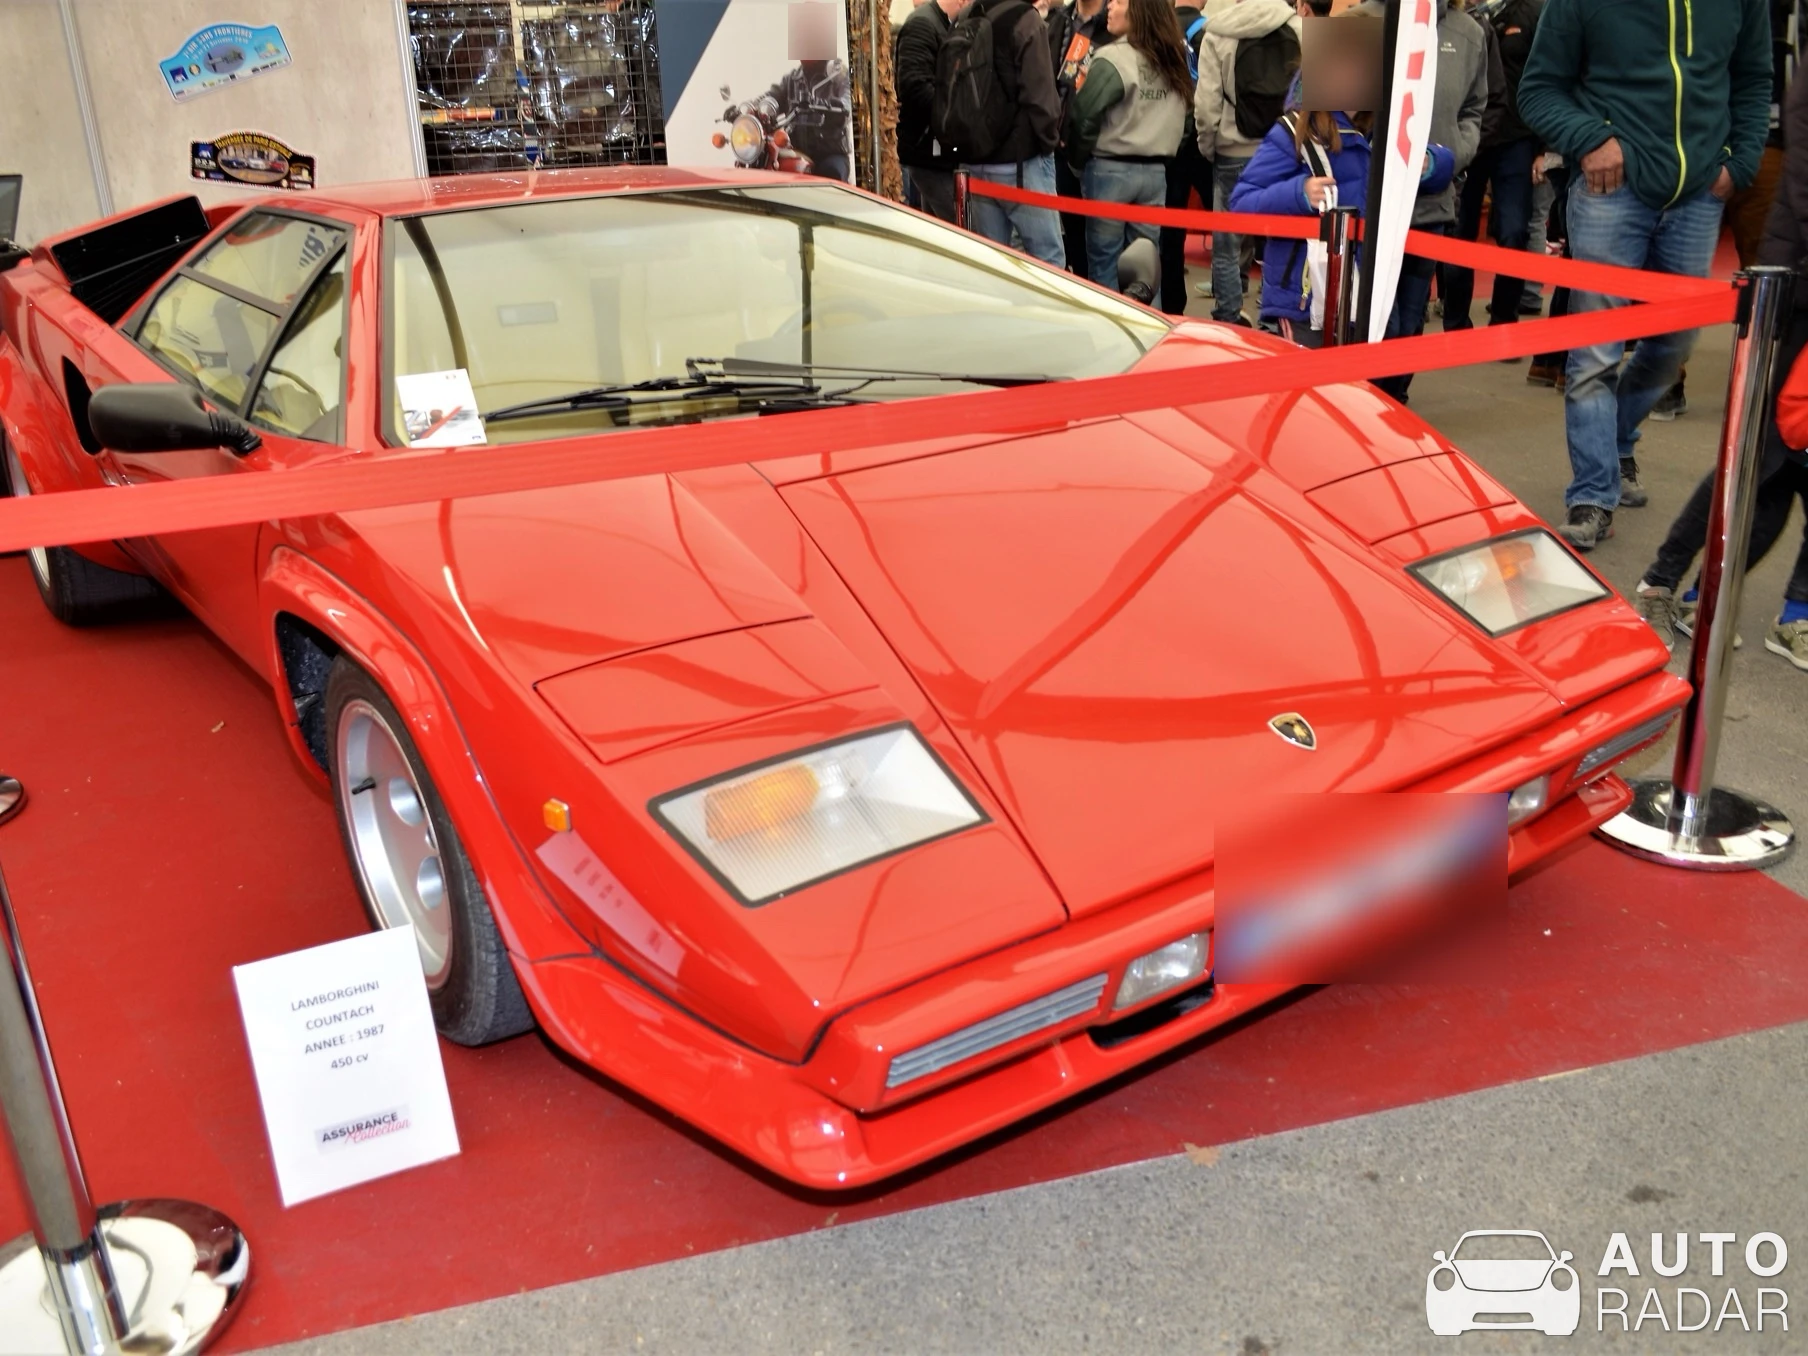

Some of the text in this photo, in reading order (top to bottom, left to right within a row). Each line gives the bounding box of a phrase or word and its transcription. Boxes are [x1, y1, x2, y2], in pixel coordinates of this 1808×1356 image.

[1139, 89, 1169, 100] SHELBY
[291, 980, 380, 1012] LAMBORGHINI
[306, 1004, 375, 1031] COUNTACH
[304, 1034, 346, 1054] ANNEE
[356, 1024, 385, 1041] 1987
[331, 1053, 369, 1070] 450 cv
[322, 1112, 398, 1143] ASSURANCE
[345, 1118, 411, 1145] Collection
